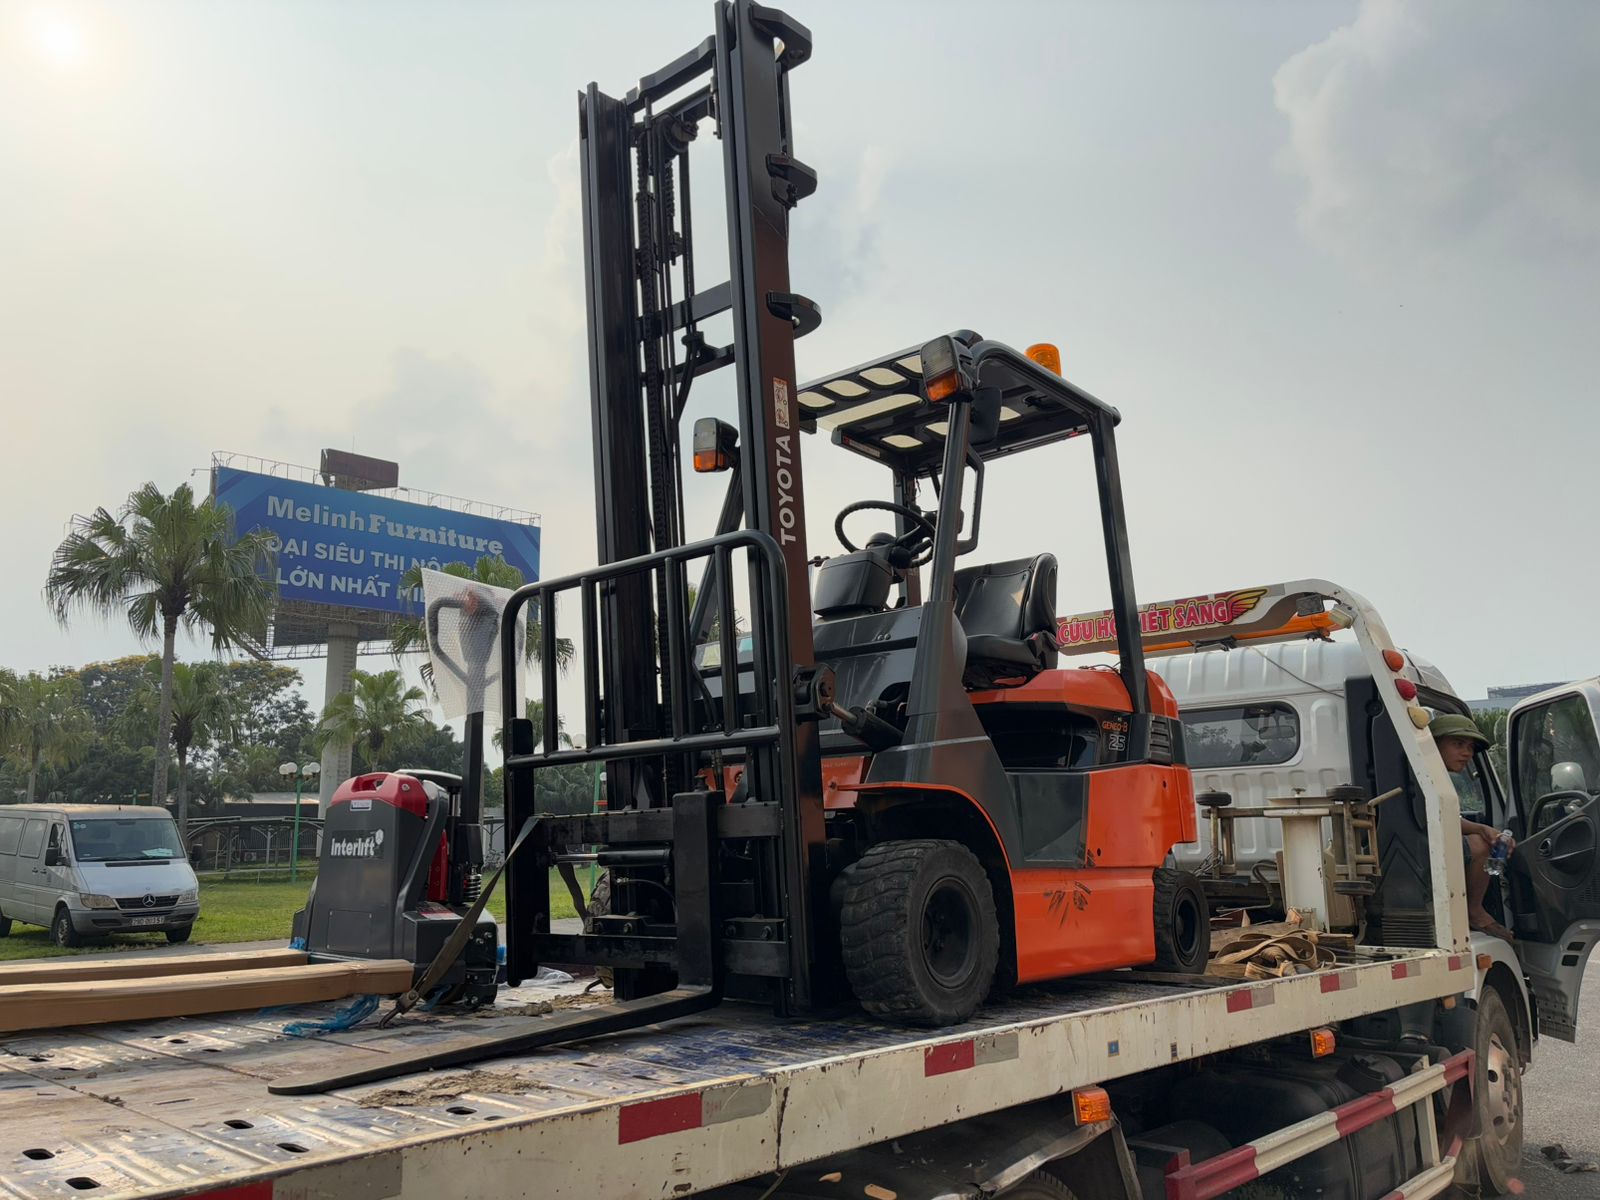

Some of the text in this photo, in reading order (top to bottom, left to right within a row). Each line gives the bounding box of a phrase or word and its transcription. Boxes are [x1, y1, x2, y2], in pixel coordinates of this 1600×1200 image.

[775, 435, 797, 546] TOYOTA
[267, 495, 504, 555] Melinh Furniture
[314, 539, 365, 566] SIÊU
[371, 551, 405, 575] THỊ
[275, 565, 324, 591] LỚN
[331, 572, 391, 599] NHẤT
[1058, 618, 1094, 645] CỨU
[1138, 604, 1171, 633] IẾT
[1175, 600, 1228, 629] SÁNG
[1109, 734, 1126, 751] 25
